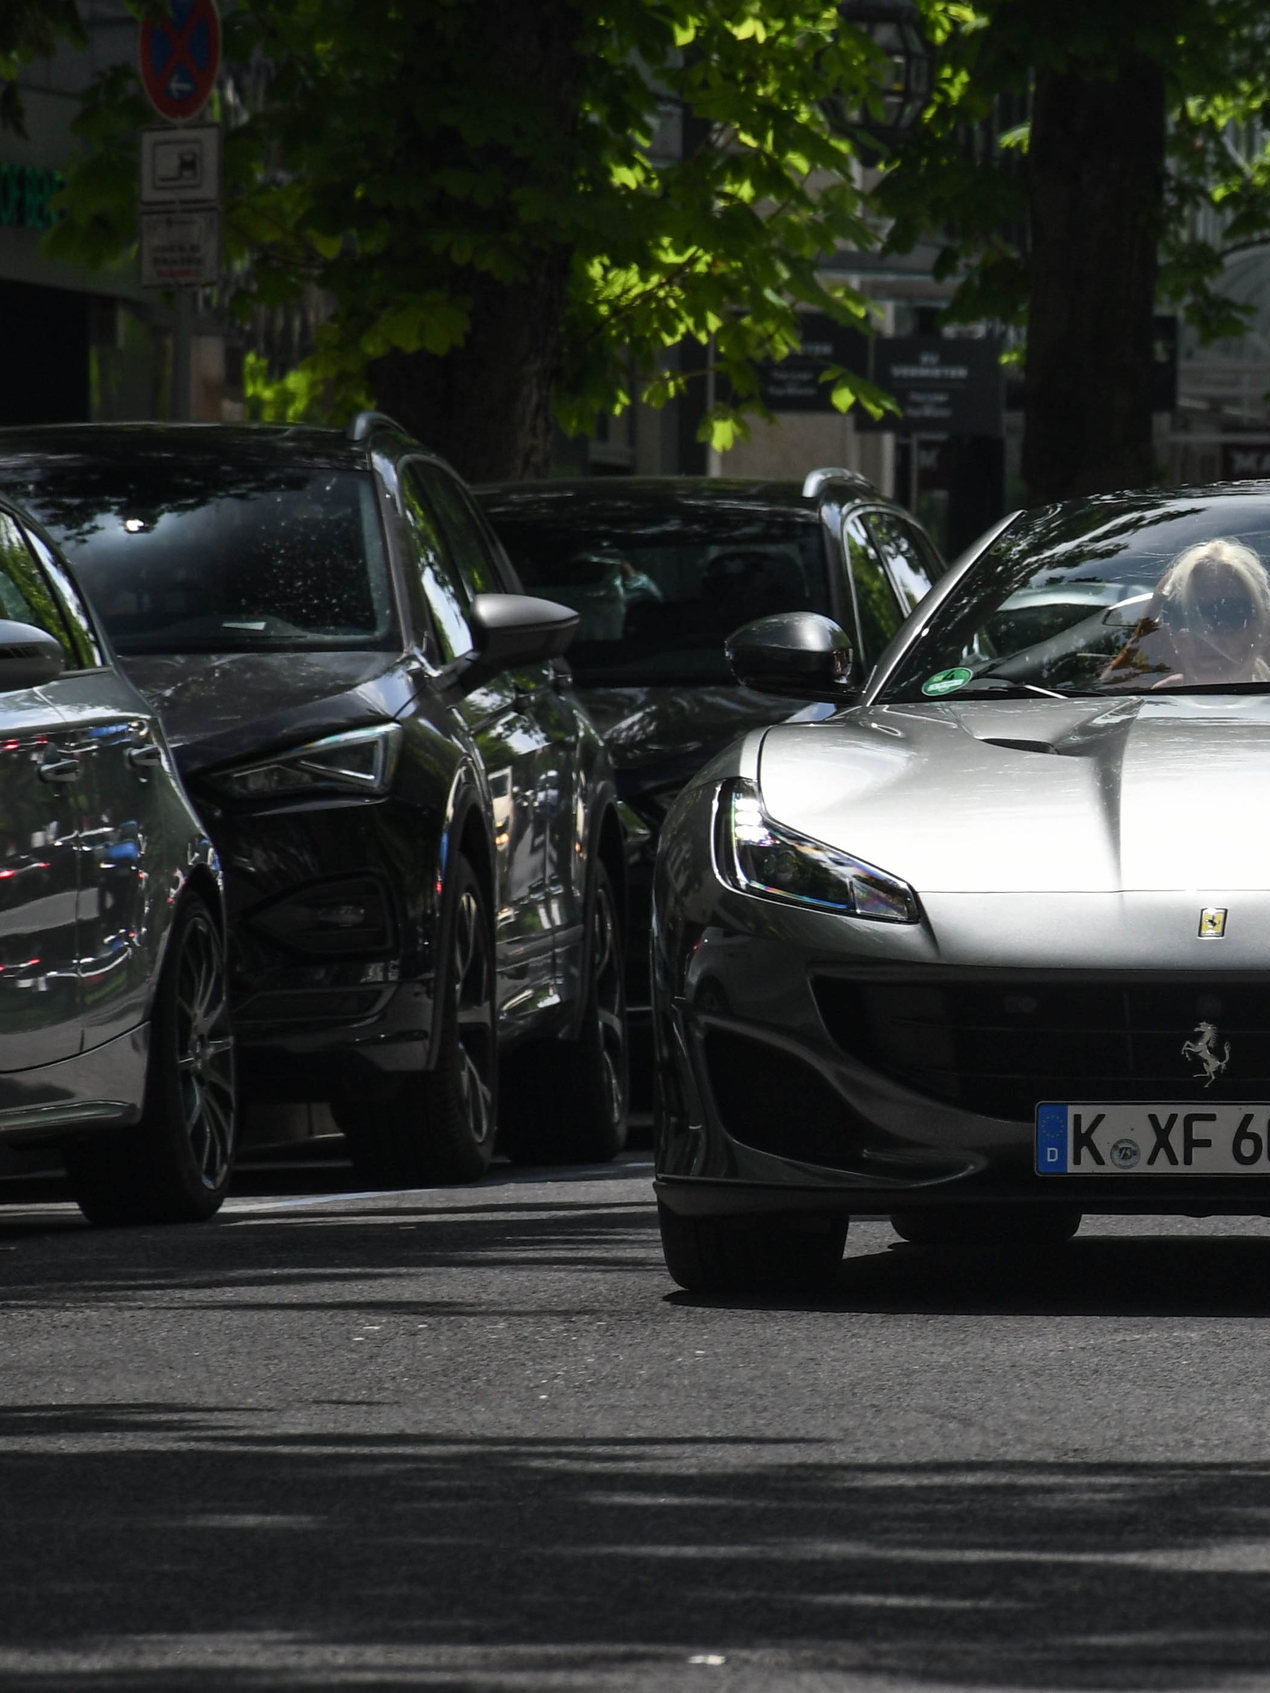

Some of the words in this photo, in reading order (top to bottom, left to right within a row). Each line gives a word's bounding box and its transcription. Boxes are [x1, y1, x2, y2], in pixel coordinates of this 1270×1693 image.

[942, 669, 956, 681] 4
[1046, 1147, 1058, 1162] D
[1072, 1113, 1106, 1166] K
[1146, 1113, 1217, 1166] XF
